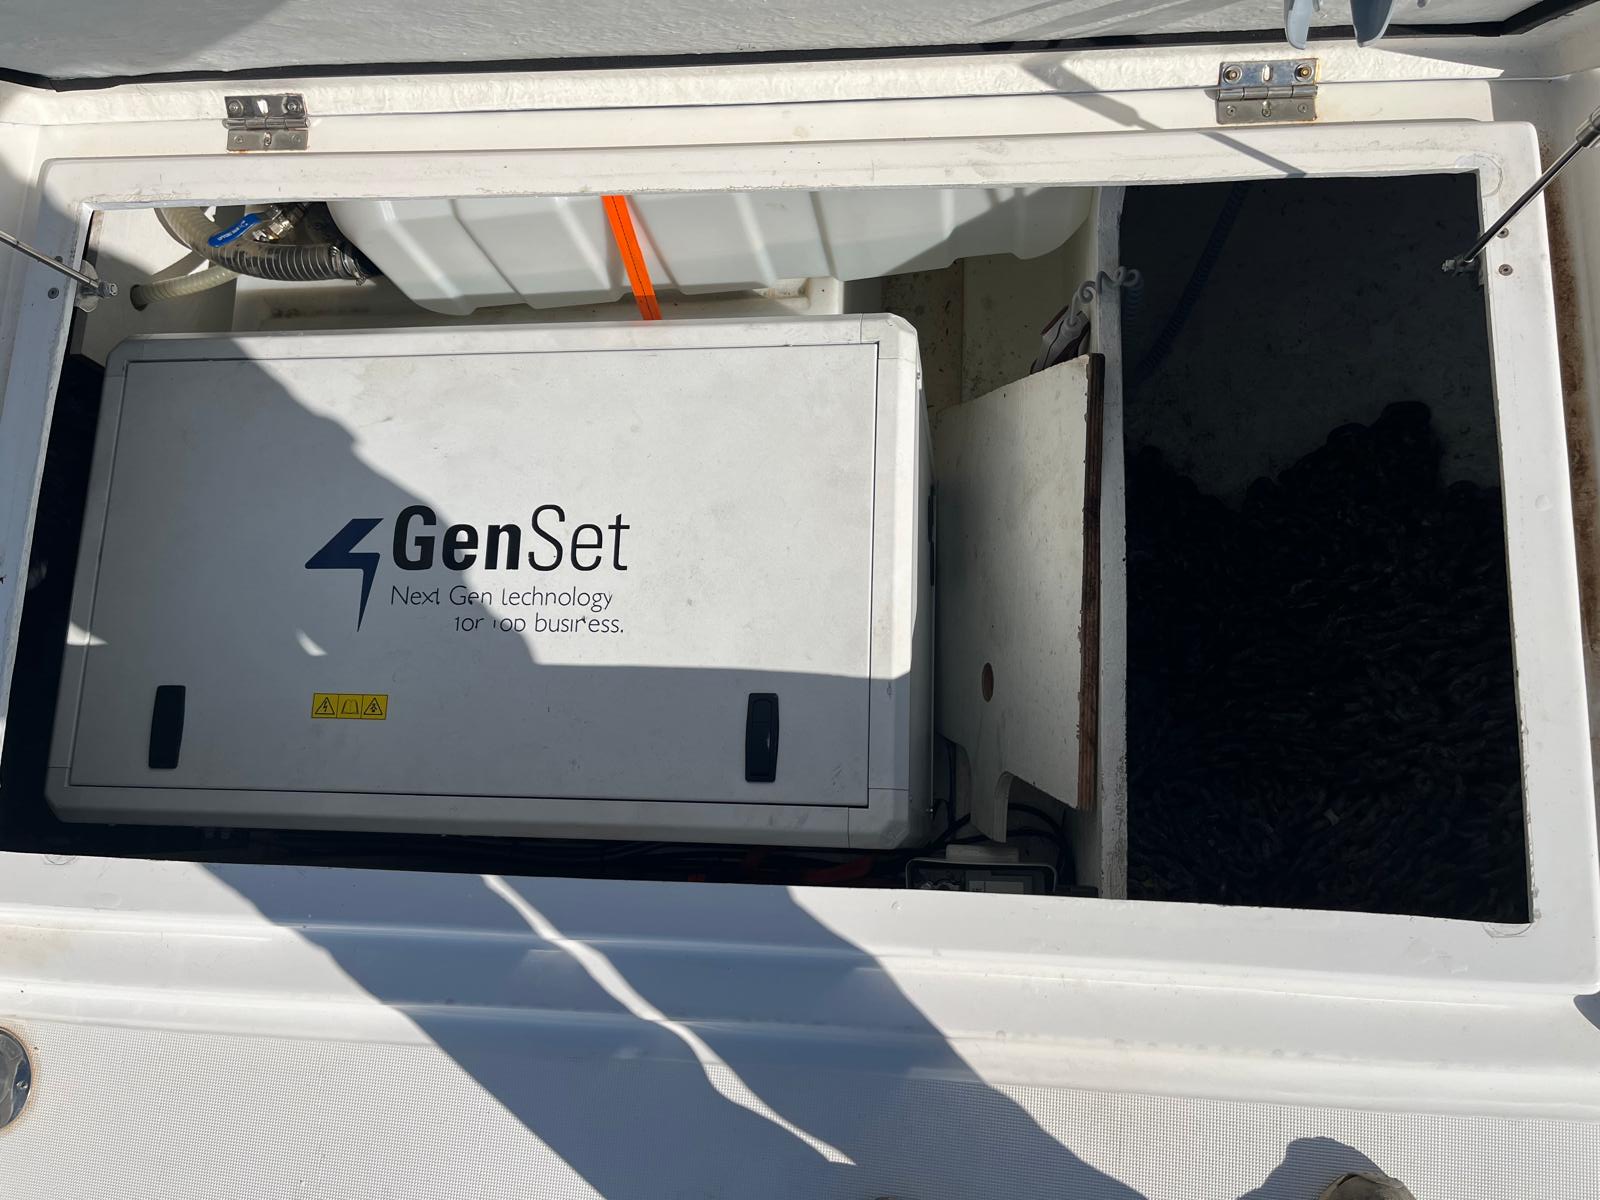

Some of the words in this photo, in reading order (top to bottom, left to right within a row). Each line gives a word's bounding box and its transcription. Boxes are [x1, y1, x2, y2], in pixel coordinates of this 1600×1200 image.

[392, 504, 631, 571] GenSet
[390, 584, 440, 606] Next
[449, 584, 493, 606] Gen
